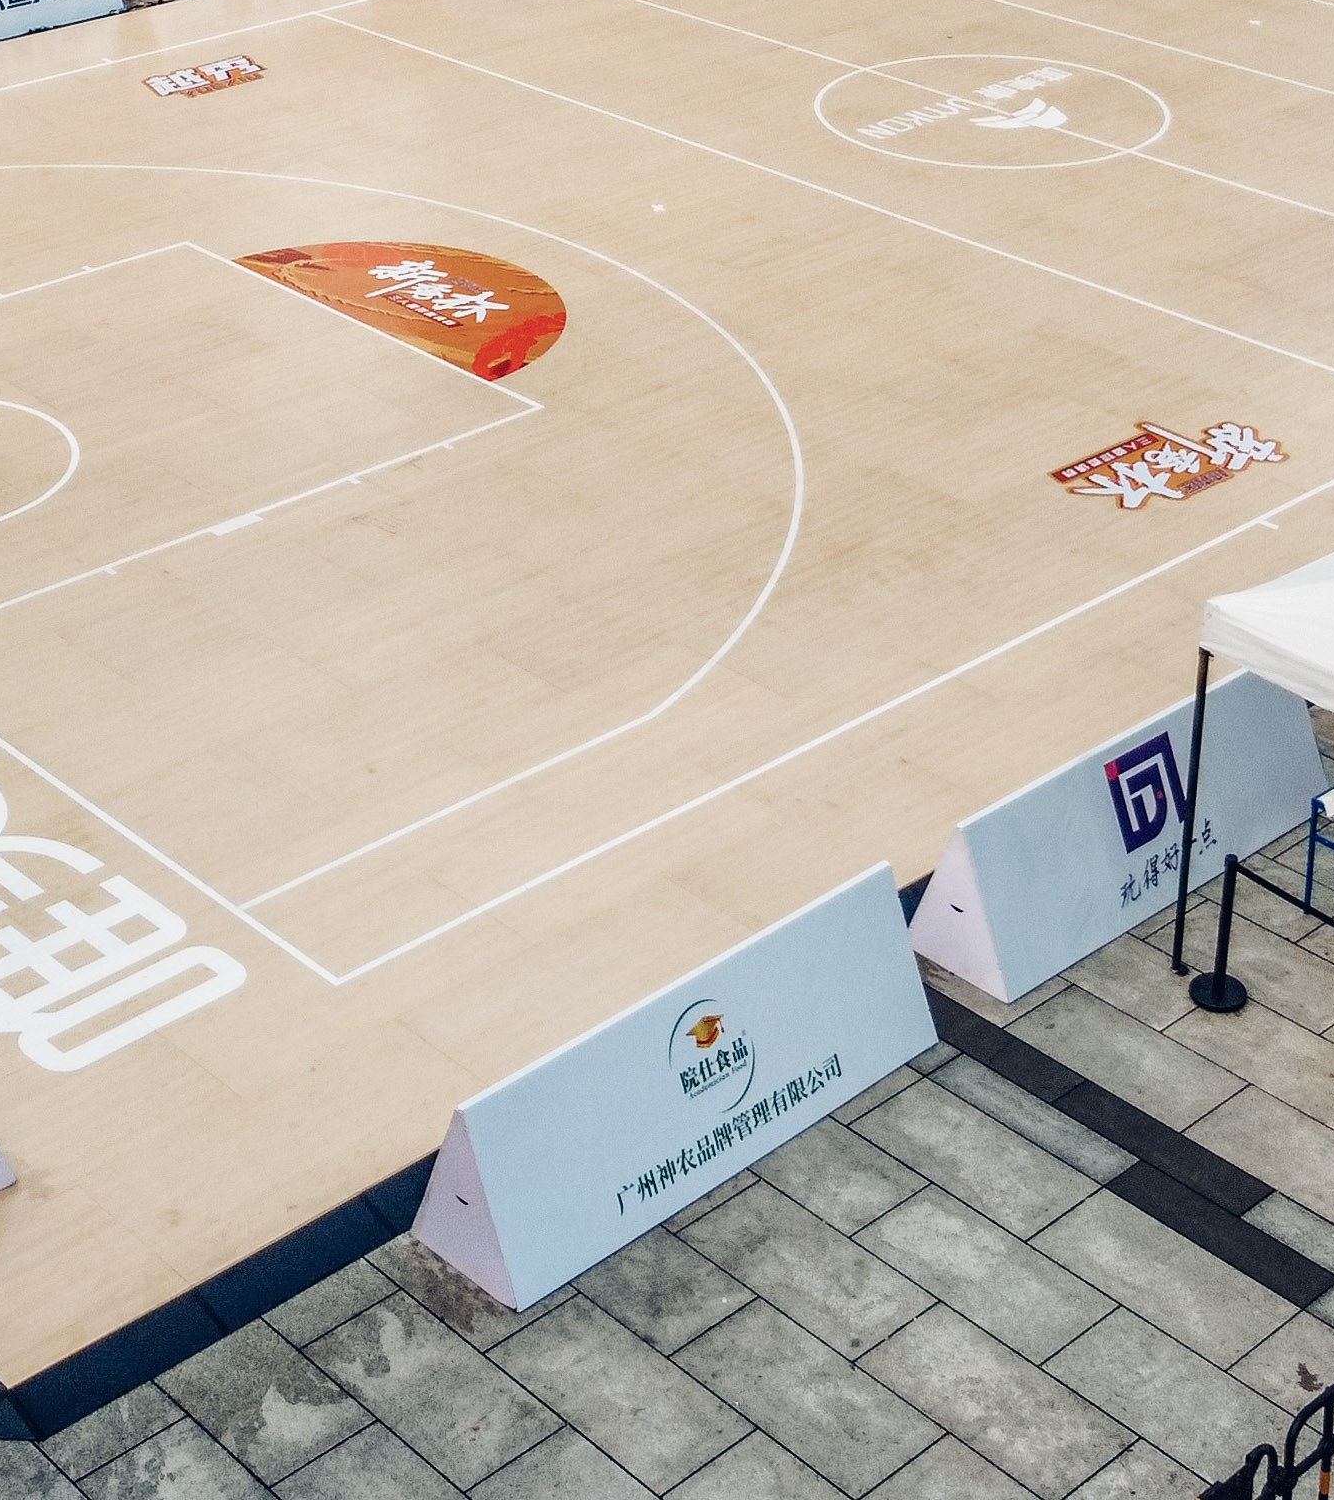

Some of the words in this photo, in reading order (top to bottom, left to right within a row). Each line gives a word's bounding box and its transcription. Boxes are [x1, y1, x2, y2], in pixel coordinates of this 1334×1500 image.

[365, 260, 510, 323] 新秀杯
[1071, 422, 1284, 508] 新秀杯
[679, 1037, 749, 1094] 院仕食品
[617, 1053, 842, 1216] 广州神农品牌管理有限公司
